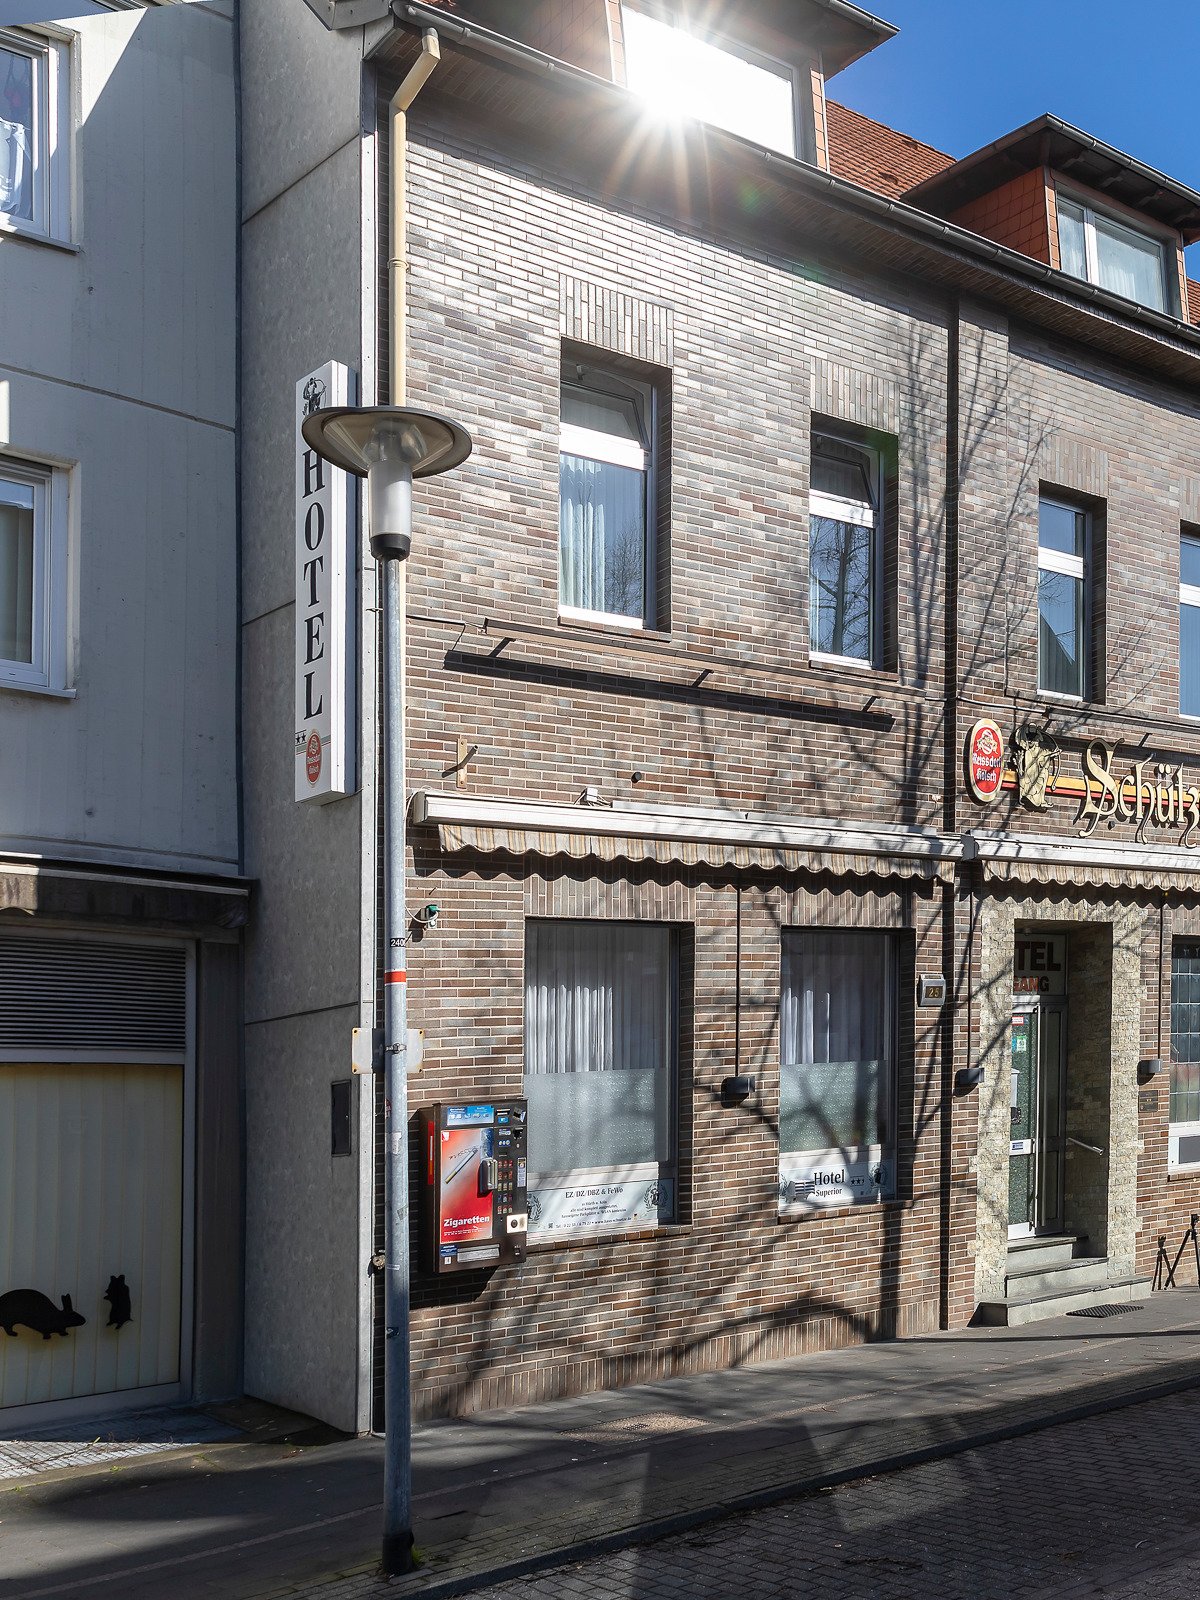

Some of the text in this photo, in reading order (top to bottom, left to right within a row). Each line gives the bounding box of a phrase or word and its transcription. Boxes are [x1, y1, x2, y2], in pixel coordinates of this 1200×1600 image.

[302, 447, 325, 721] HOTEL
[1014, 941, 1062, 971] TEL
[928, 988, 940, 997] 25
[814, 1169, 845, 1186] Hotel
[815, 1188, 843, 1198] Superior
[443, 1215, 490, 1228] Zigaretten
